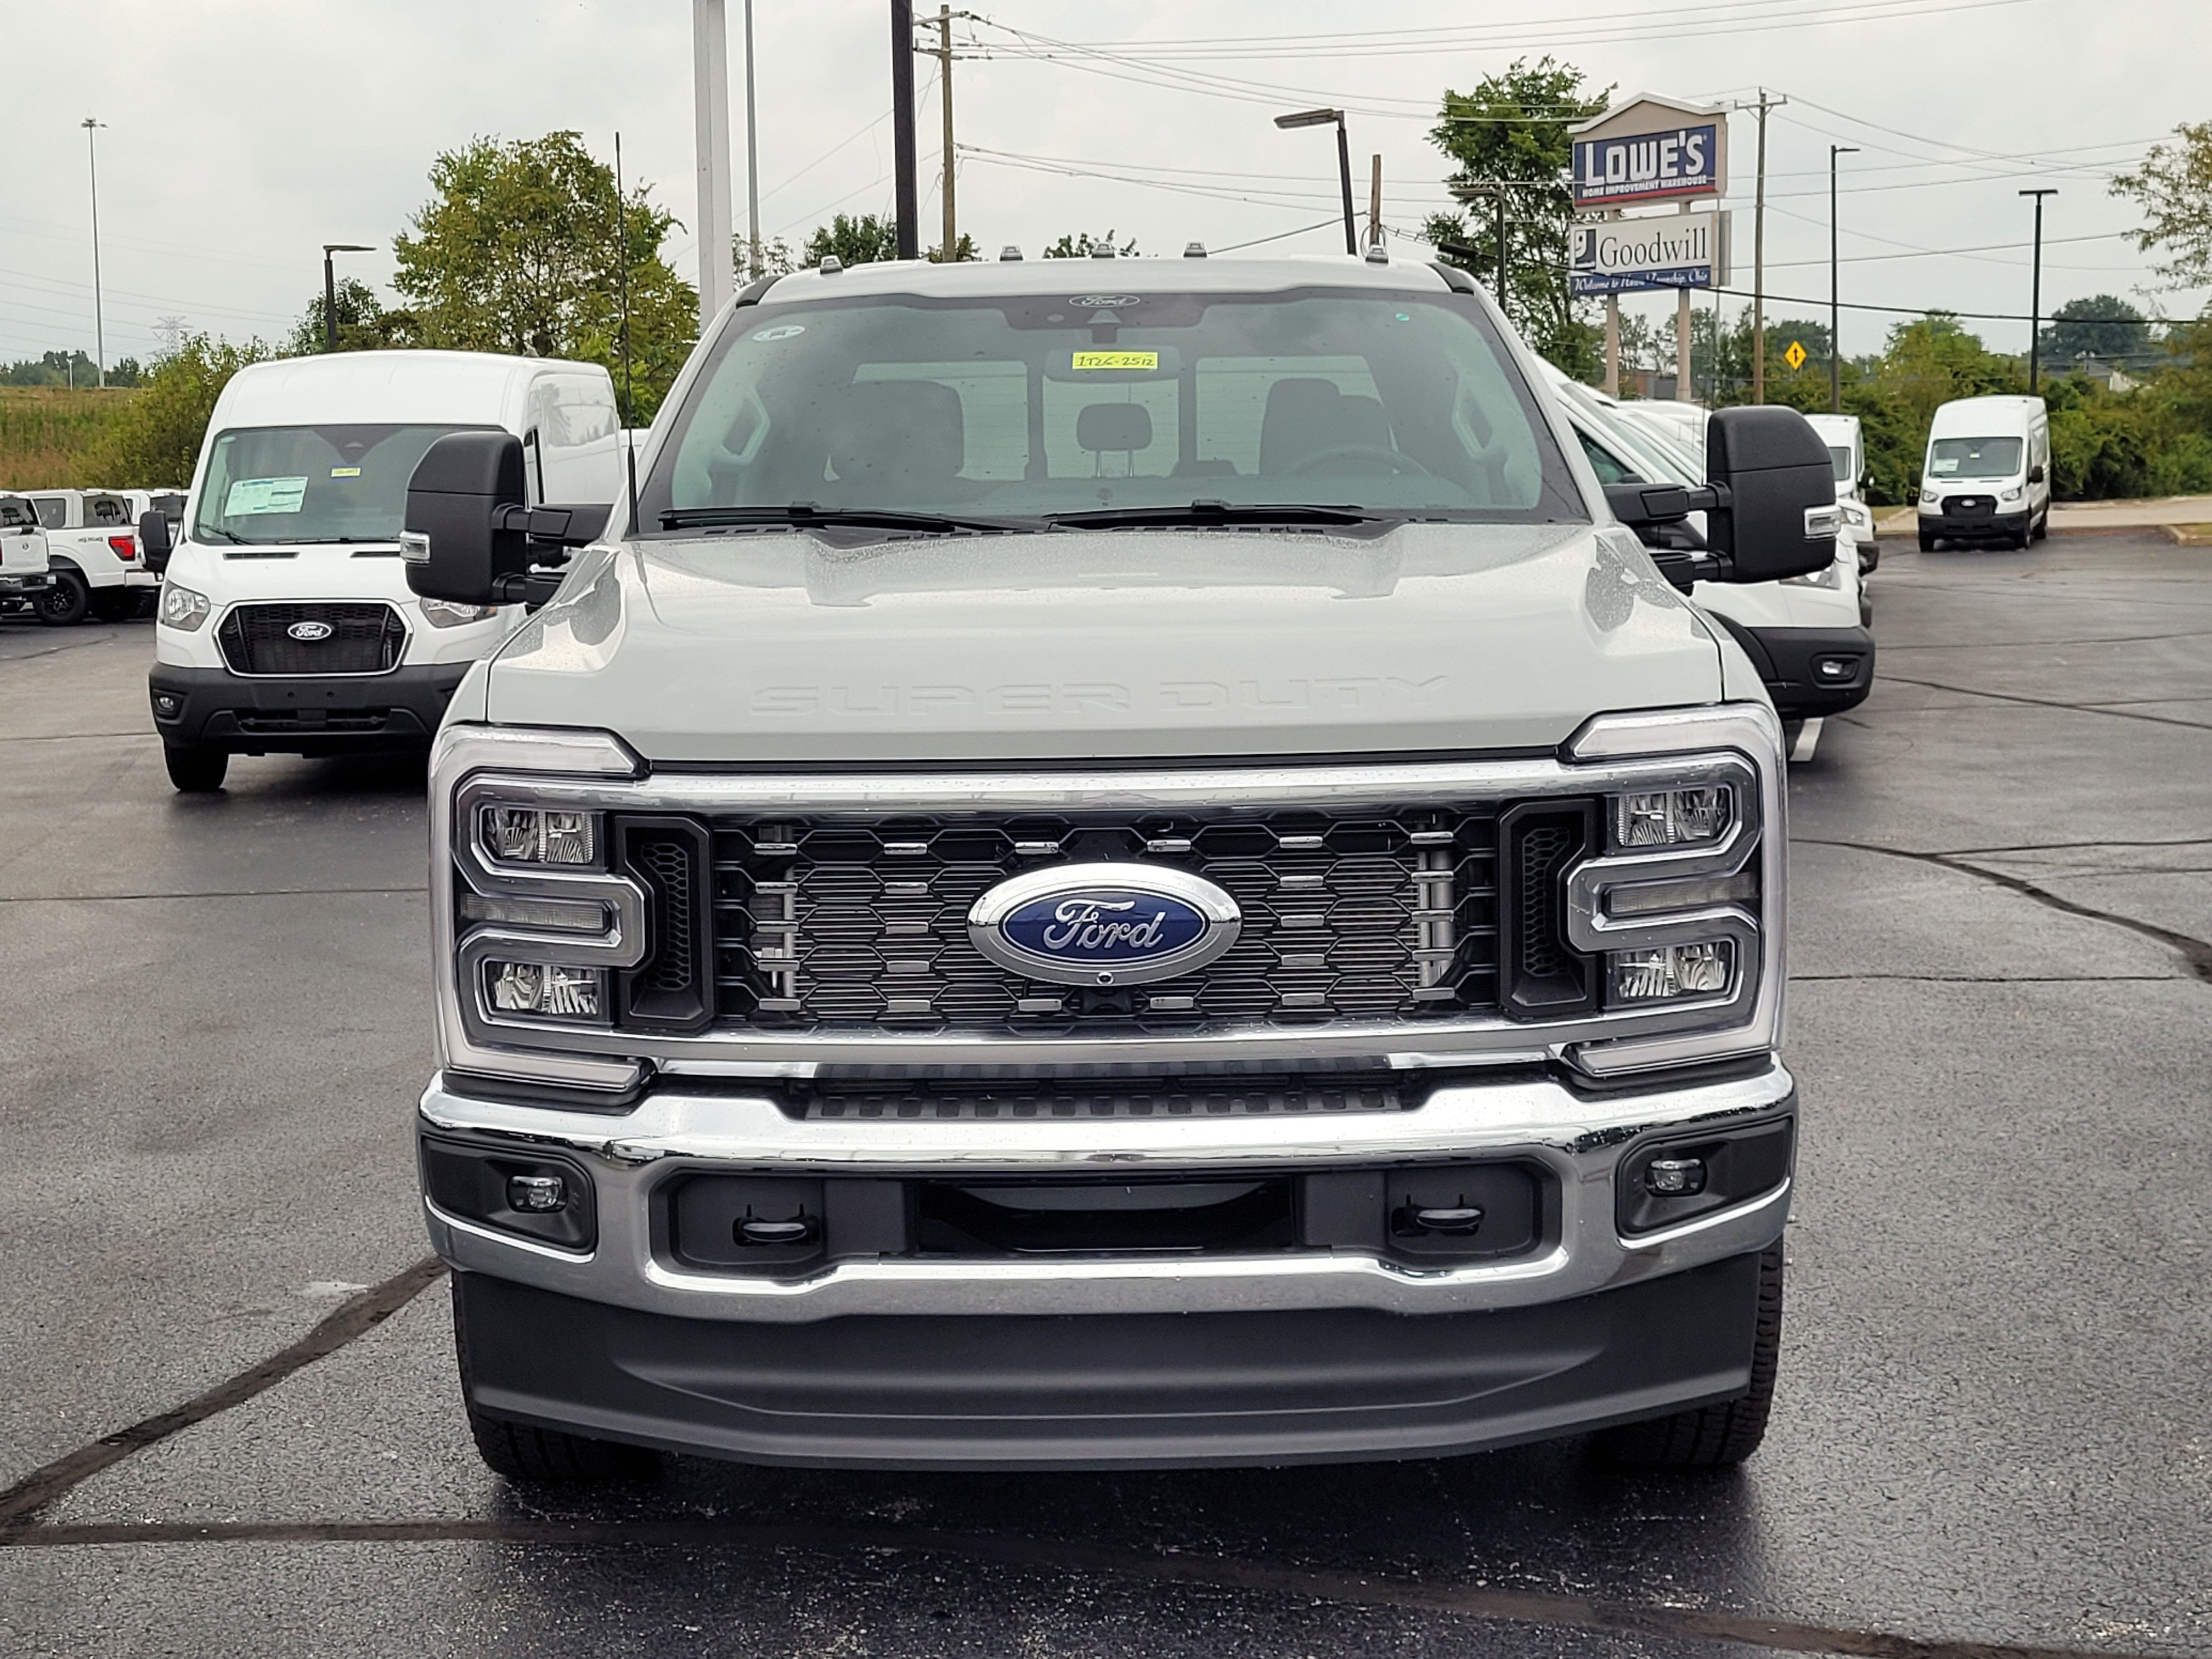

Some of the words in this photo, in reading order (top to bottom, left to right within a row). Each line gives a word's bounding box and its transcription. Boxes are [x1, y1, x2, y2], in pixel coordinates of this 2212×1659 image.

[1585, 131, 1705, 187] LOWE'S
[1582, 187, 1605, 198] HOME
[1605, 182, 1659, 196] IMPROVEMENT
[1660, 176, 1707, 189] WAREHOUSE
[1600, 227, 1707, 268] Goodwill
[1081, 296, 1127, 306] Ford
[296, 625, 324, 637] Ford
[751, 683, 1131, 715] SUPER
[1160, 675, 1448, 711] DUTY
[1043, 899, 1166, 950] Ford
